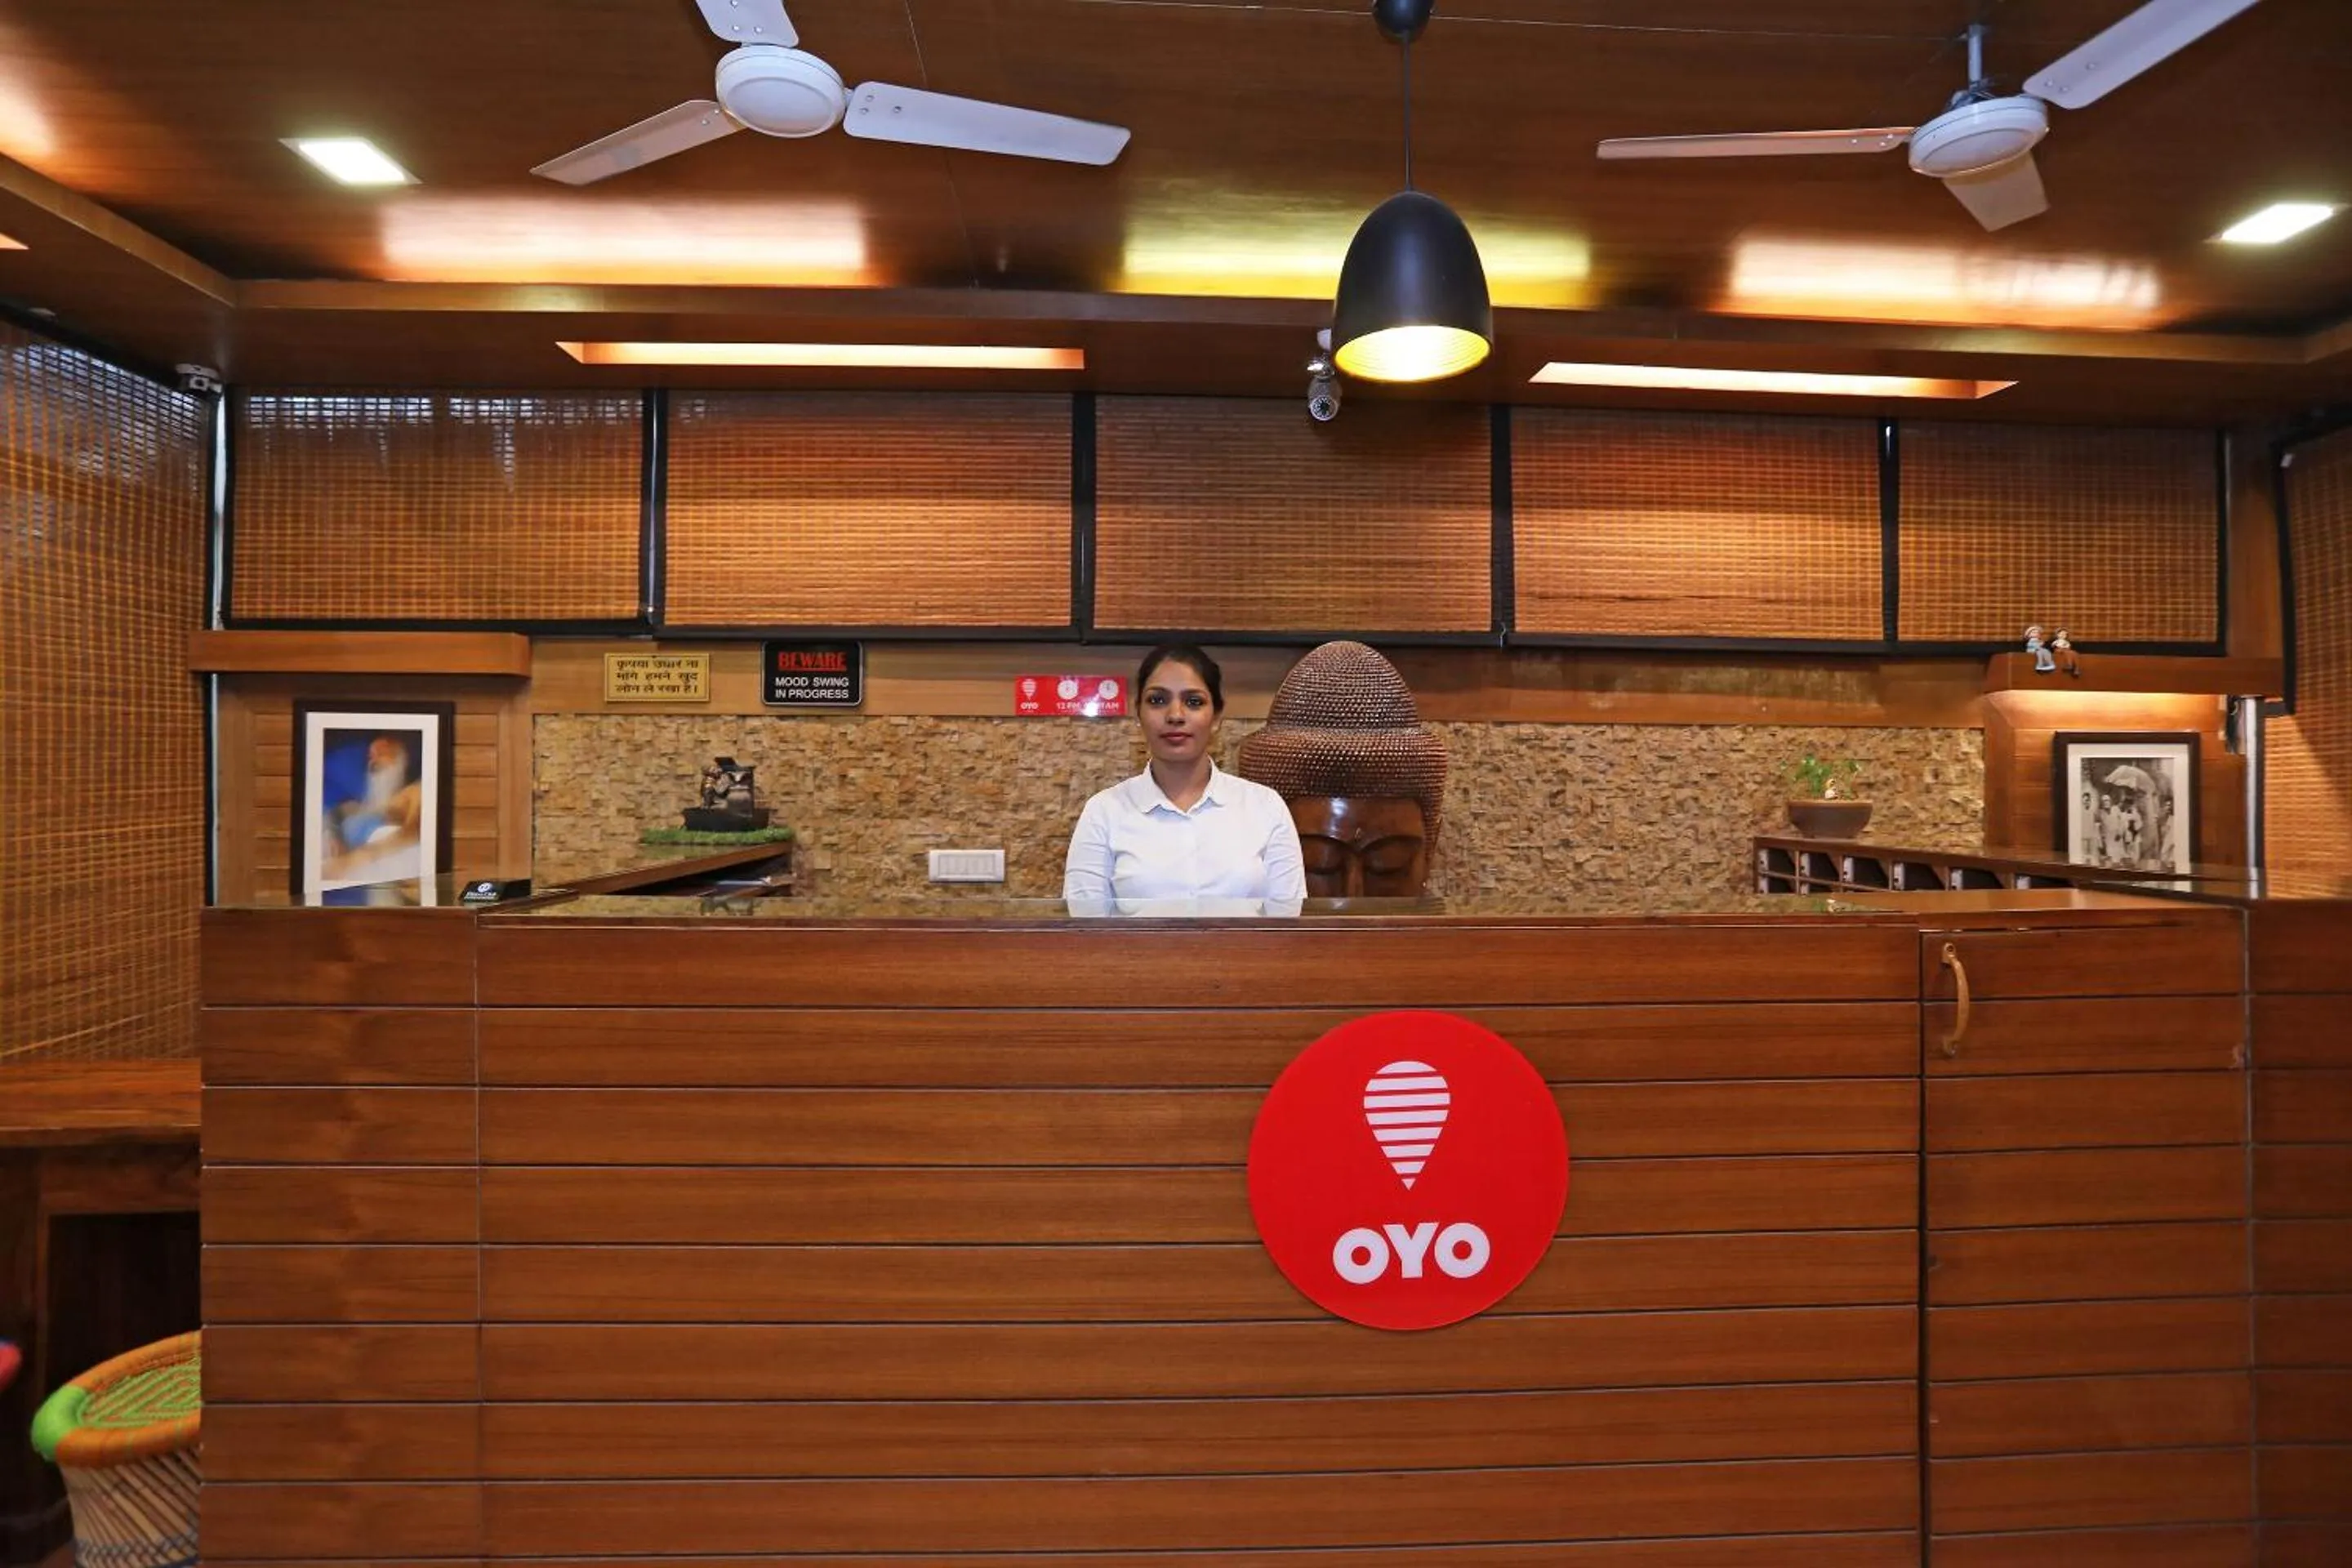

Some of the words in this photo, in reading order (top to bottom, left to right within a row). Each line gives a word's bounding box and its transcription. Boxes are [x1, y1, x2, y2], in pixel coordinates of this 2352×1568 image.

[617, 659, 649, 670] कृपया
[777, 651, 848, 670] BEWARE
[775, 677, 809, 687] MOOD
[813, 677, 849, 687] SWING
[775, 689, 786, 699] IN
[788, 689, 849, 699] PROGRESS
[1333, 1222, 1490, 1285] OYO
